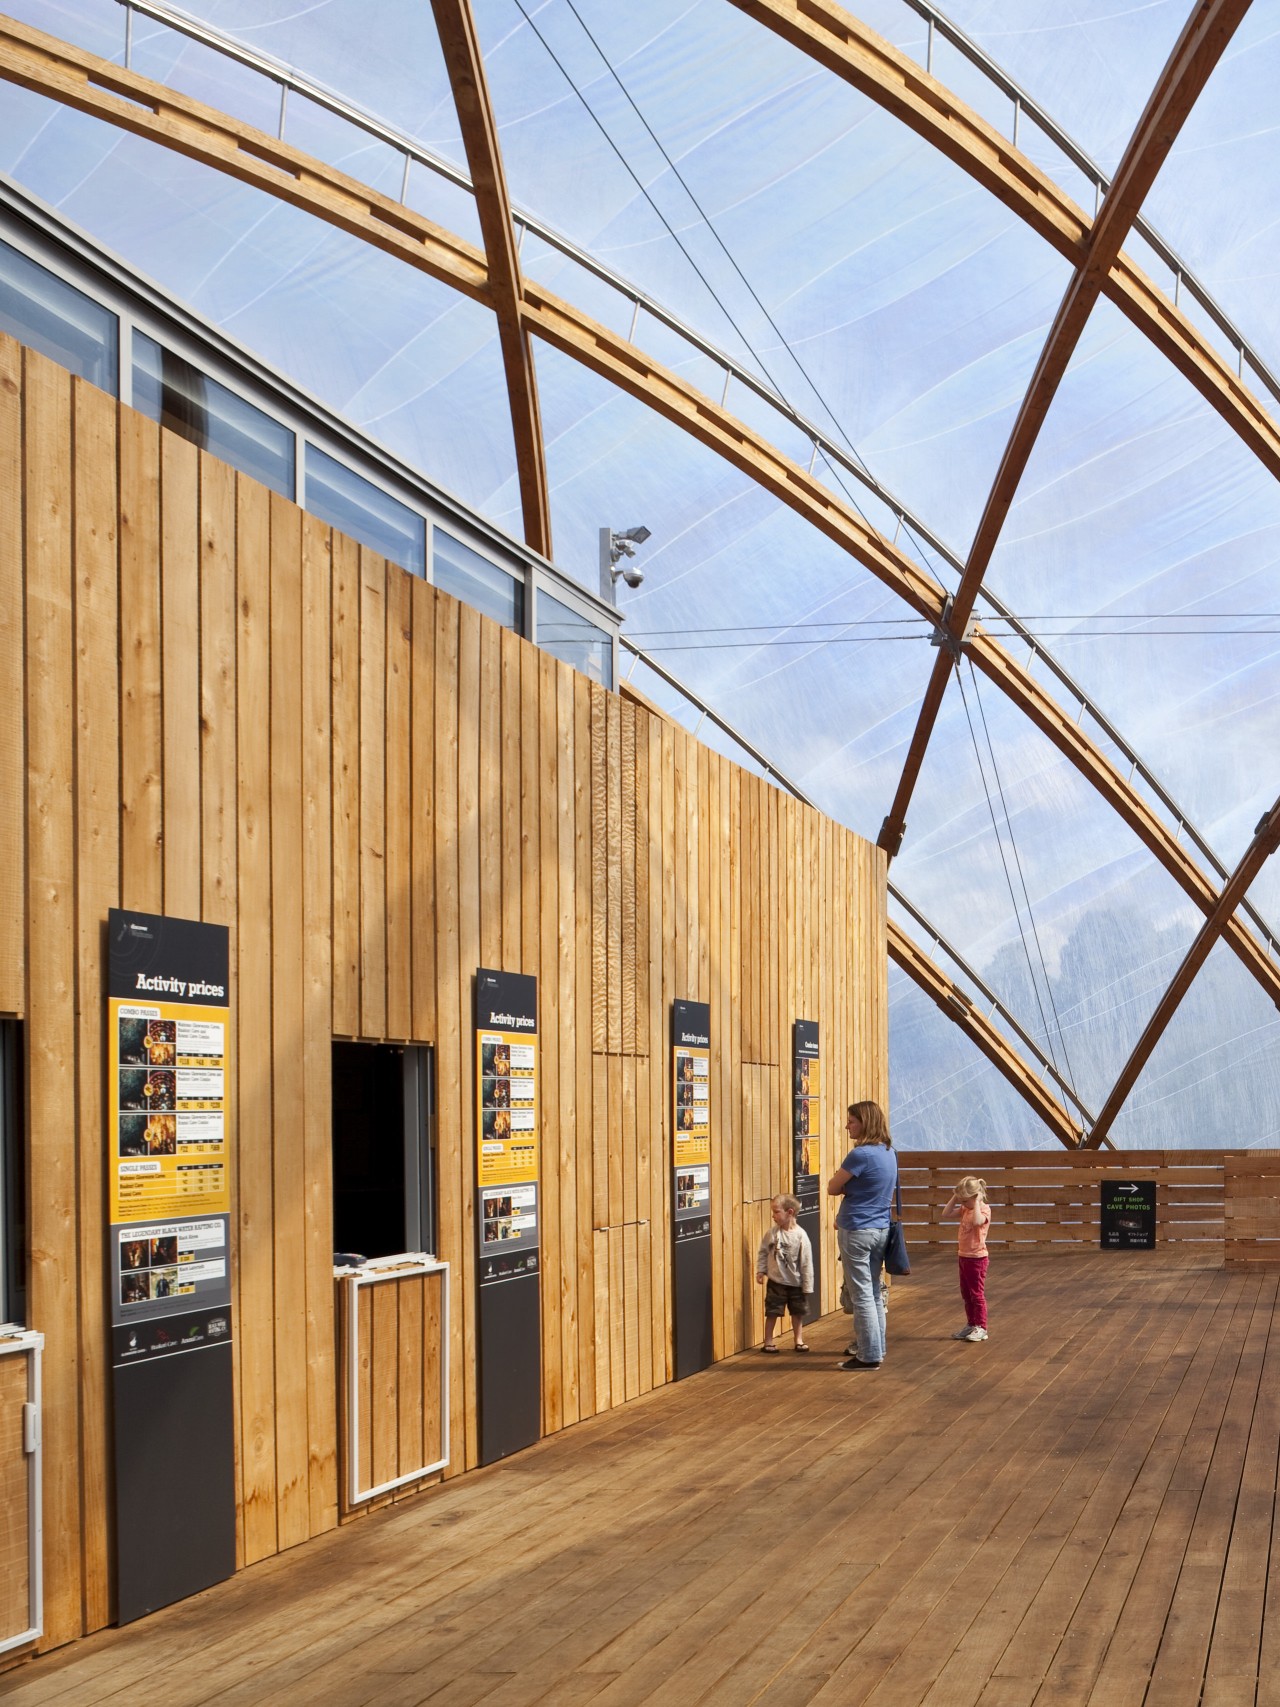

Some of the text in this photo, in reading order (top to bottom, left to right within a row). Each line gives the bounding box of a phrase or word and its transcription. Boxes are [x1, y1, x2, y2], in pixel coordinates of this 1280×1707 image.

[136, 973, 225, 997] Activity prices
[490, 1011, 535, 1028] Activity prices
